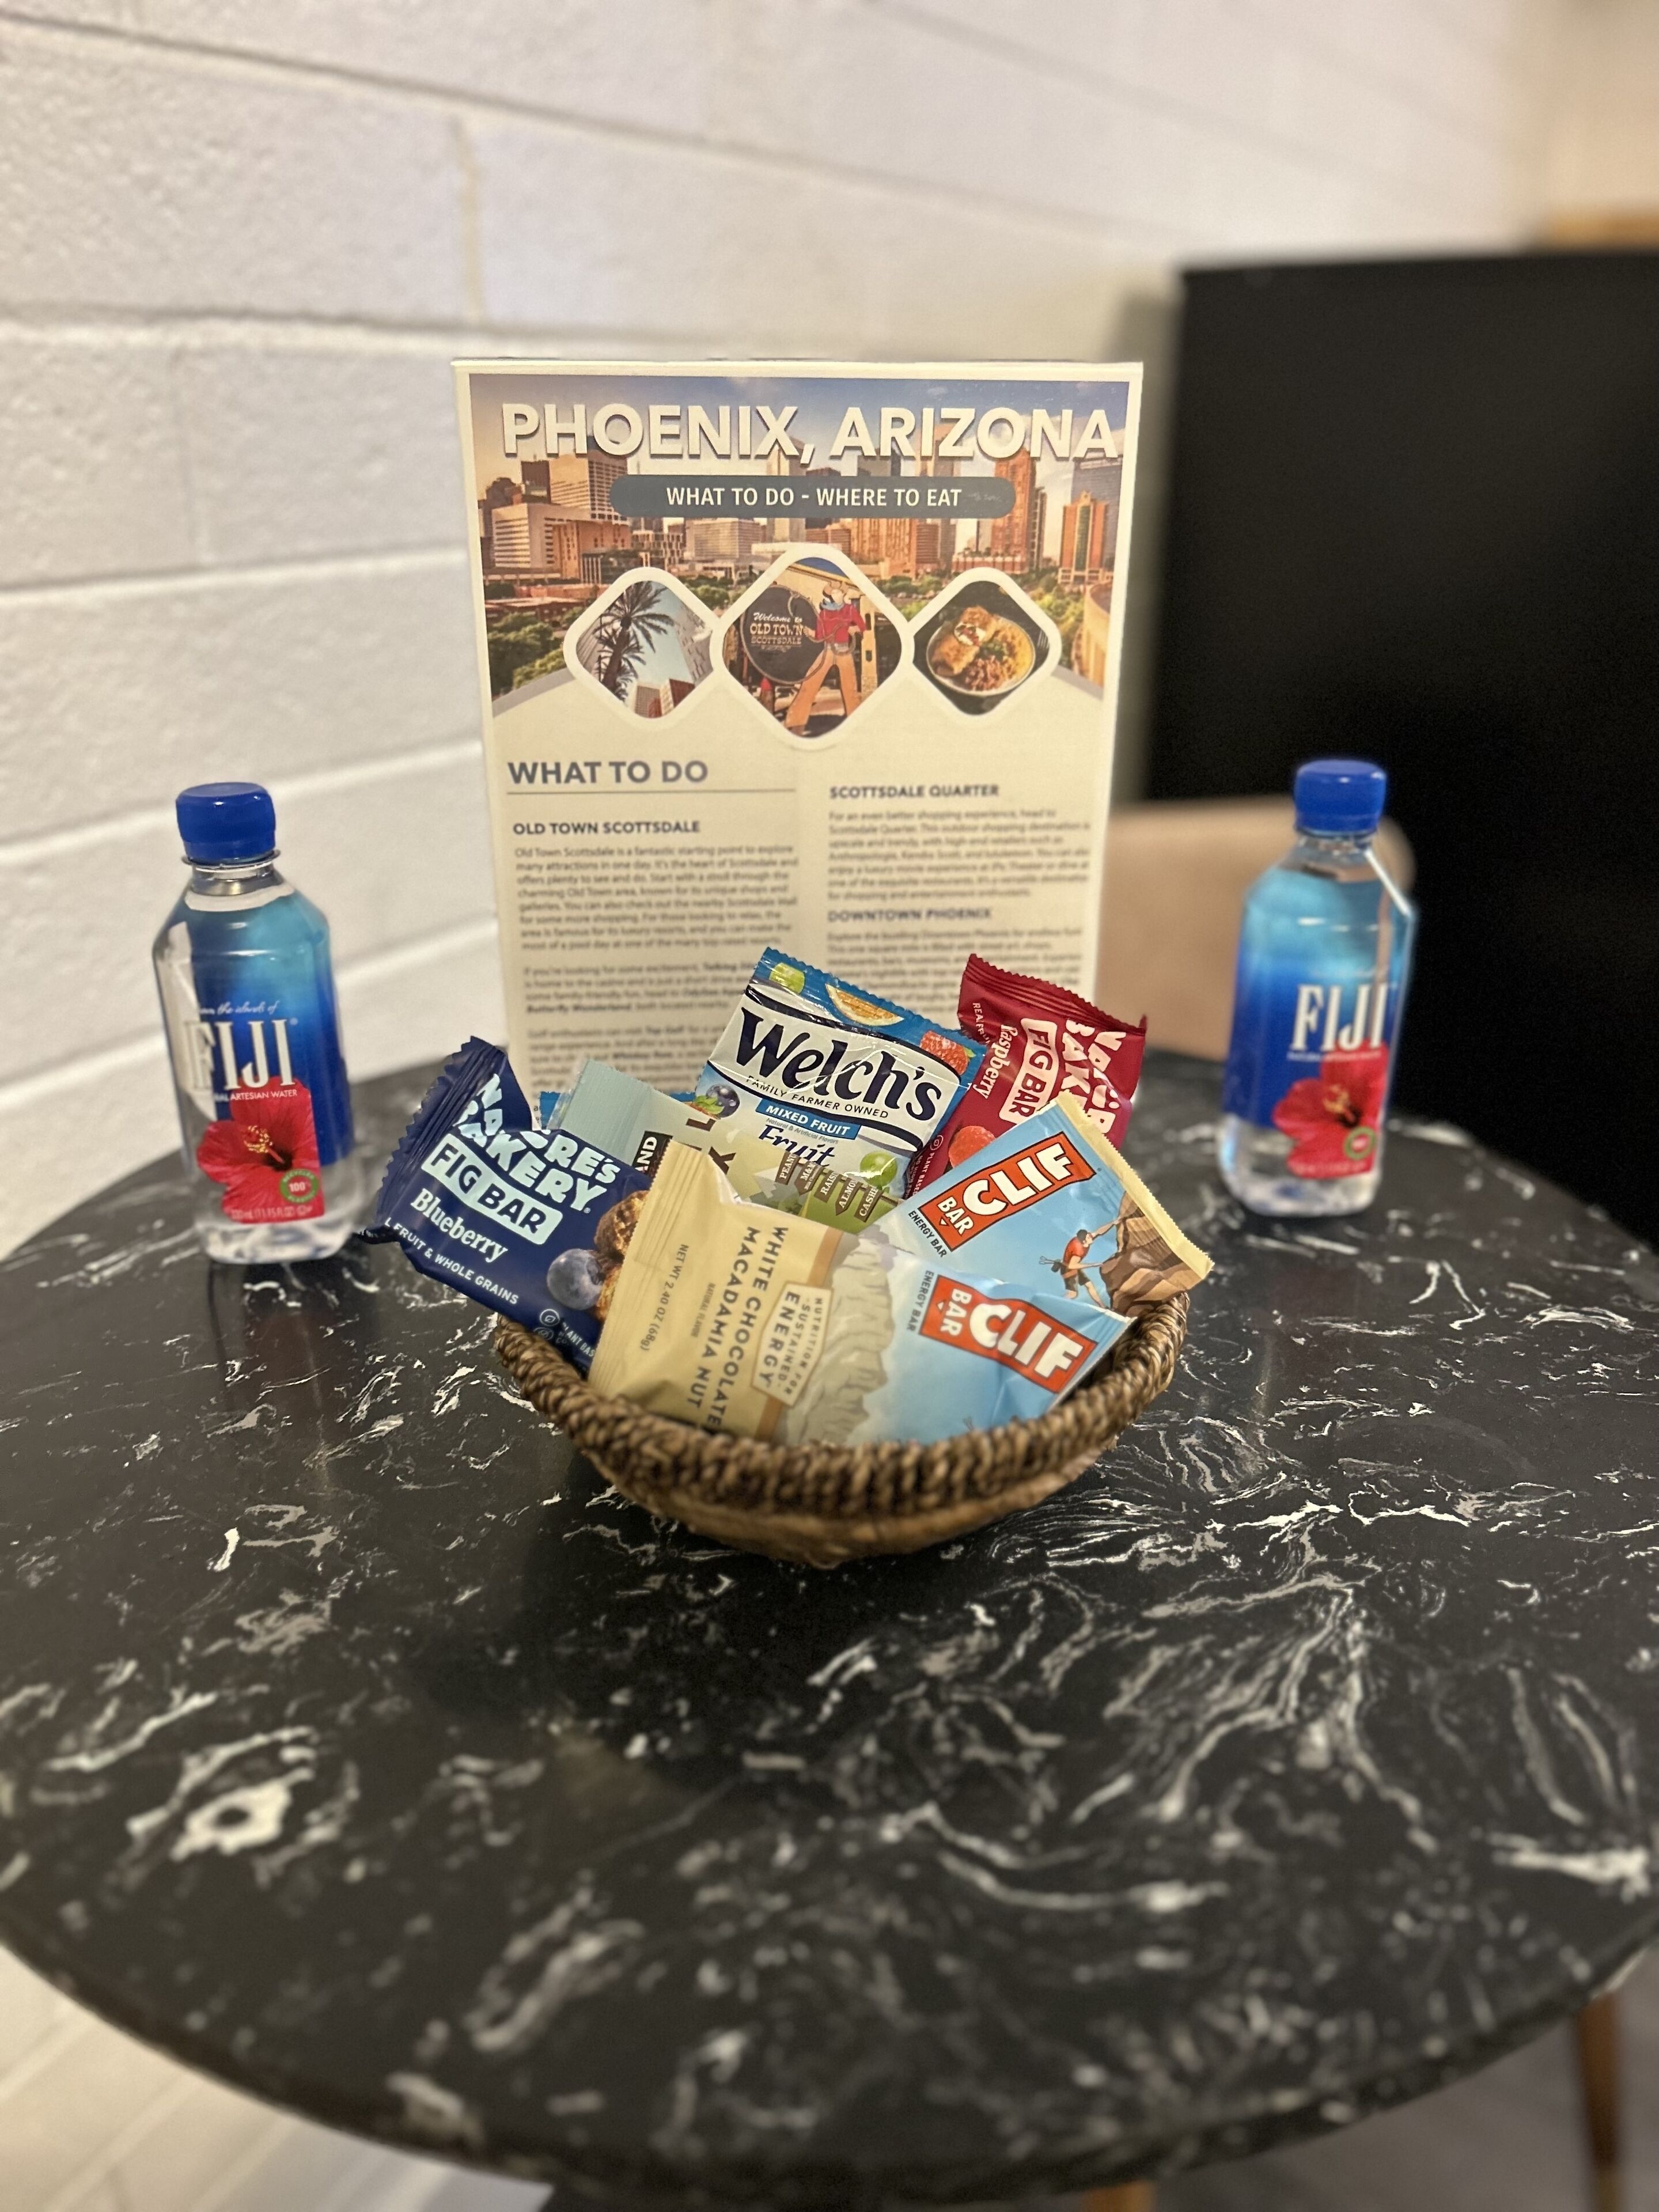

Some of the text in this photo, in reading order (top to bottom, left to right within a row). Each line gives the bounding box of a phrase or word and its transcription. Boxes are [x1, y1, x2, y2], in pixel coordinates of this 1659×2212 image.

[502, 403, 1119, 465] PHOENIX, ARIZONA
[666, 487, 725, 506] WHAT
[731, 488, 759, 506] TO
[766, 488, 795, 506] DO
[816, 488, 887, 506] WHERE
[894, 488, 920, 506] TO
[927, 489, 962, 506] EAT
[750, 623, 804, 636] OLD TOWN
[753, 612, 791, 623] Welcome
[751, 637, 801, 645] SCOTTSDALE
[508, 760, 709, 784] WHAT TO DO
[830, 785, 999, 800] SCOTTSDALE QUARTER
[513, 821, 700, 835] OLD TOWN SCOTTSDALE
[1290, 983, 1388, 1052] FIJI
[184, 1018, 296, 1091] FIJI
[736, 1006, 942, 1122] Welch's
[972, 1024, 1018, 1099] Raspberry
[1009, 1028, 1053, 1118] FIG BAR
[230, 1091, 269, 1101] ARTESIAN
[271, 1089, 298, 1098] WATER
[747, 1075, 889, 1119] FAMILY FARMER OWNED
[766, 1105, 851, 1136] MIXED FRUIT
[766, 1118, 788, 1131] Natural
[758, 1124, 836, 1167] Fruit
[922, 1152, 935, 1173] PLANT
[431, 1142, 547, 1234] FIG BAR
[962, 1142, 1074, 1216] CLIF
[411, 1188, 508, 1263] Blueberry
[908, 1210, 934, 1240] ENERGY
[930, 1236, 948, 1258] BAR
[937, 1196, 975, 1236] BAR
[393, 1222, 426, 1251] FRUIT
[424, 1248, 434, 1259] &
[435, 1253, 475, 1281] WHOLE
[475, 1275, 519, 1305] GRAINS
[669, 1266, 683, 1281] WT
[676, 1244, 690, 1263] NET
[654, 1306, 666, 1323] OZ
[660, 1281, 675, 1305] 2.40
[906, 1270, 934, 1332] ENERGY BAR
[940, 1288, 972, 1336] BAR
[687, 1226, 762, 1408] MACADAMIA NUT
[707, 1226, 789, 1426] WHITE CHOCOLATE
[759, 1290, 801, 1388] ENERGY
[579, 1342, 595, 1357] BAS
[778, 1304, 811, 1381] SUSTAINED
[784, 1297, 823, 1395] NUTRITION FOR
[969, 1303, 1084, 1378] CLIF
